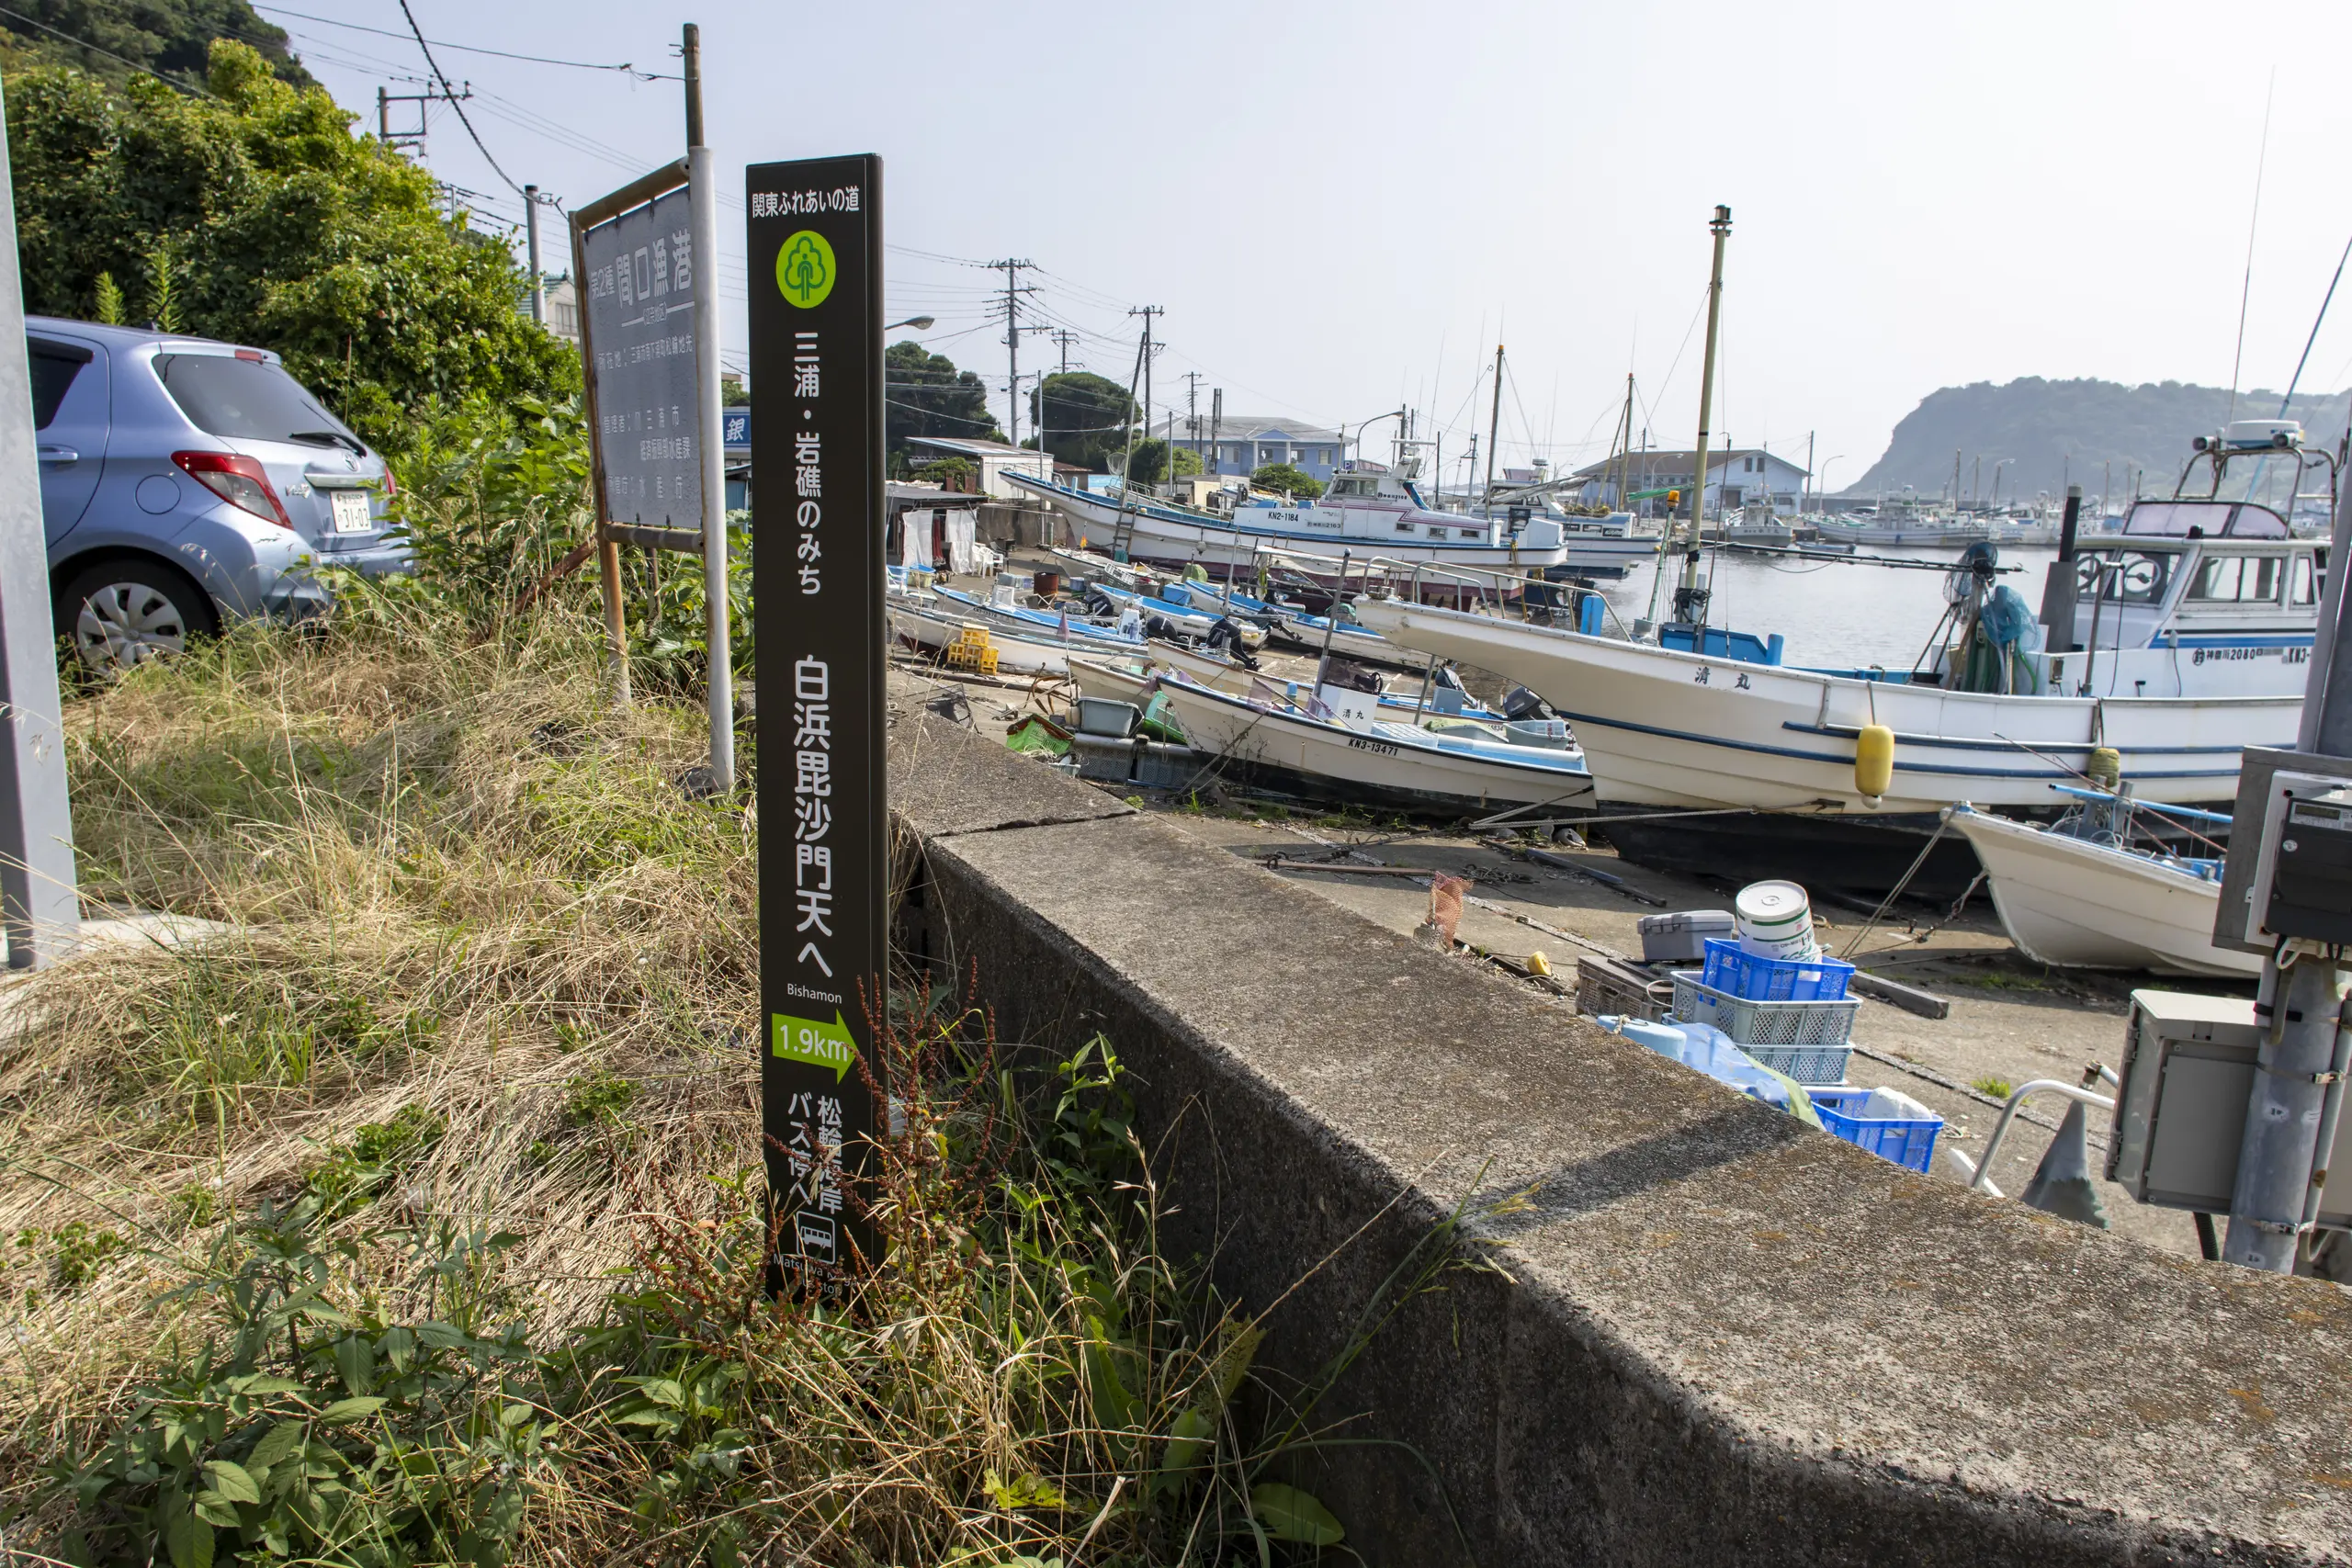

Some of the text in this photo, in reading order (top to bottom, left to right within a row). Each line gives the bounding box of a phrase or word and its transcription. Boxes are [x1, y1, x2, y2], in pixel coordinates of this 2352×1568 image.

[752, 186, 860, 218] 関東ふれあいの道
[726, 417, 746, 442] 銀
[794, 333, 822, 595] 三浦・岩礁のみち
[1268, 511, 1299, 522] KN2-1184
[1348, 739, 1398, 756] KN3-13471
[794, 654, 833, 978] 白浜毘沙門天へ
[786, 982, 842, 1005] Bishamon
[780, 1024, 848, 1063] 1.9km
